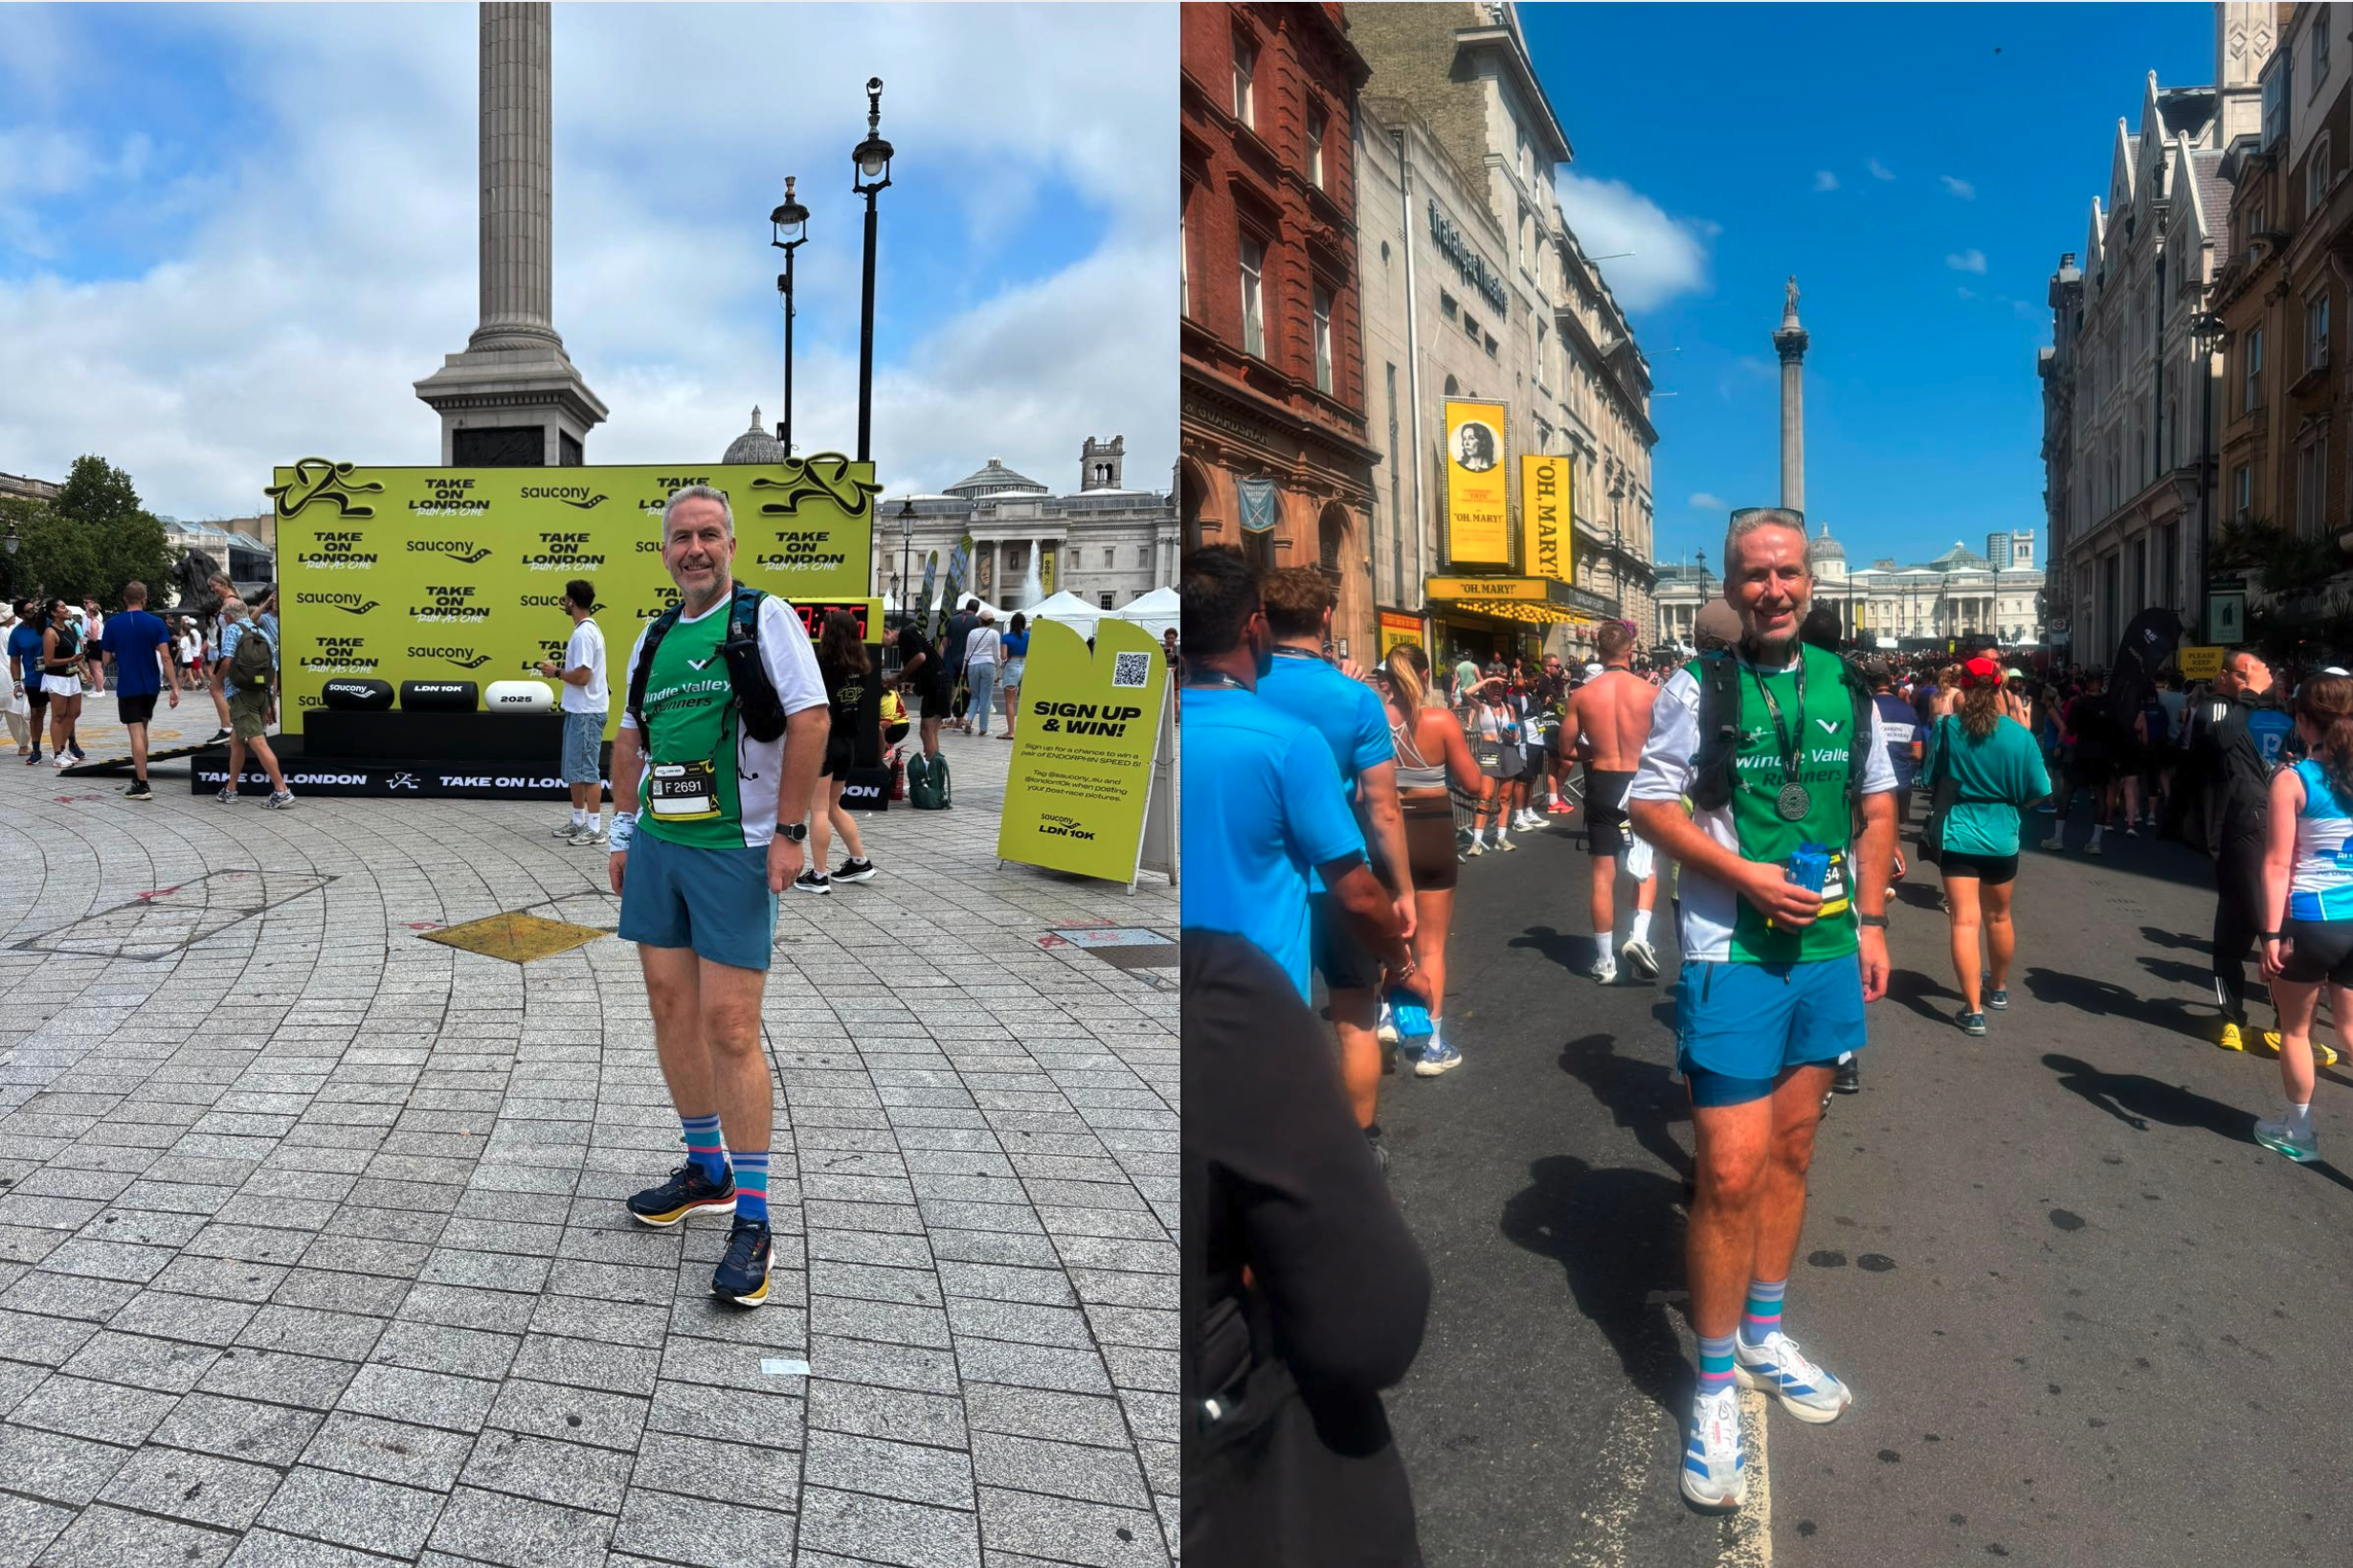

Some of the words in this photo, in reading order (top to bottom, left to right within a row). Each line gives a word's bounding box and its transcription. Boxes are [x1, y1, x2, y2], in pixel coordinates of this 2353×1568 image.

[1198, 406, 1268, 444] GUARDSMAN
[425, 479, 476, 488] TAKE
[657, 478, 709, 487] TAKE
[436, 490, 464, 500] ON
[521, 486, 590, 500] saucony
[409, 500, 490, 509] LONDON
[314, 532, 363, 542] TAKE
[539, 533, 591, 542] TAKE
[775, 532, 830, 542] TAKE
[325, 542, 351, 551] ON
[406, 540, 474, 555] saucony
[549, 544, 578, 553] ON
[786, 543, 818, 552] ON
[298, 553, 377, 563] LONDON
[522, 555, 605, 565] LONDON
[756, 553, 845, 564] LONDON
[426, 586, 476, 595] TAKE
[297, 593, 362, 606] saucony
[437, 597, 464, 606] ON
[410, 607, 490, 616] LONDON
[316, 638, 364, 647] TAKE
[326, 647, 353, 657] ON
[408, 647, 475, 661] saucony
[301, 658, 379, 667] LONDON
[329, 683, 368, 693] saucony
[682, 680, 731, 693] Valley
[1034, 701, 1097, 718] SIGN
[1102, 706, 1141, 721] UP
[1042, 718, 1061, 731] &
[1066, 720, 1126, 737] WIN!
[1074, 748, 1105, 756] chance
[1811, 749, 1849, 763] Valle
[1046, 752, 1099, 763] ENDORPHIN
[1099, 757, 1132, 766] SPEED
[283, 773, 368, 785] LONDON
[439, 776, 492, 787] TAKE
[495, 777, 526, 787] ON
[1048, 772, 1103, 783] @saucony_eu
[665, 782, 672, 793] F
[674, 781, 702, 793] 2691
[1024, 776, 1070, 787] @london10k
[1071, 781, 1093, 790] when
[1095, 785, 1128, 795] posting
[1045, 786, 1084, 796] post-race
[1085, 793, 1122, 802] pictures.
[1041, 813, 1074, 824] saucony
[1040, 825, 1068, 836] LDN
[1070, 830, 1095, 840] 10K
